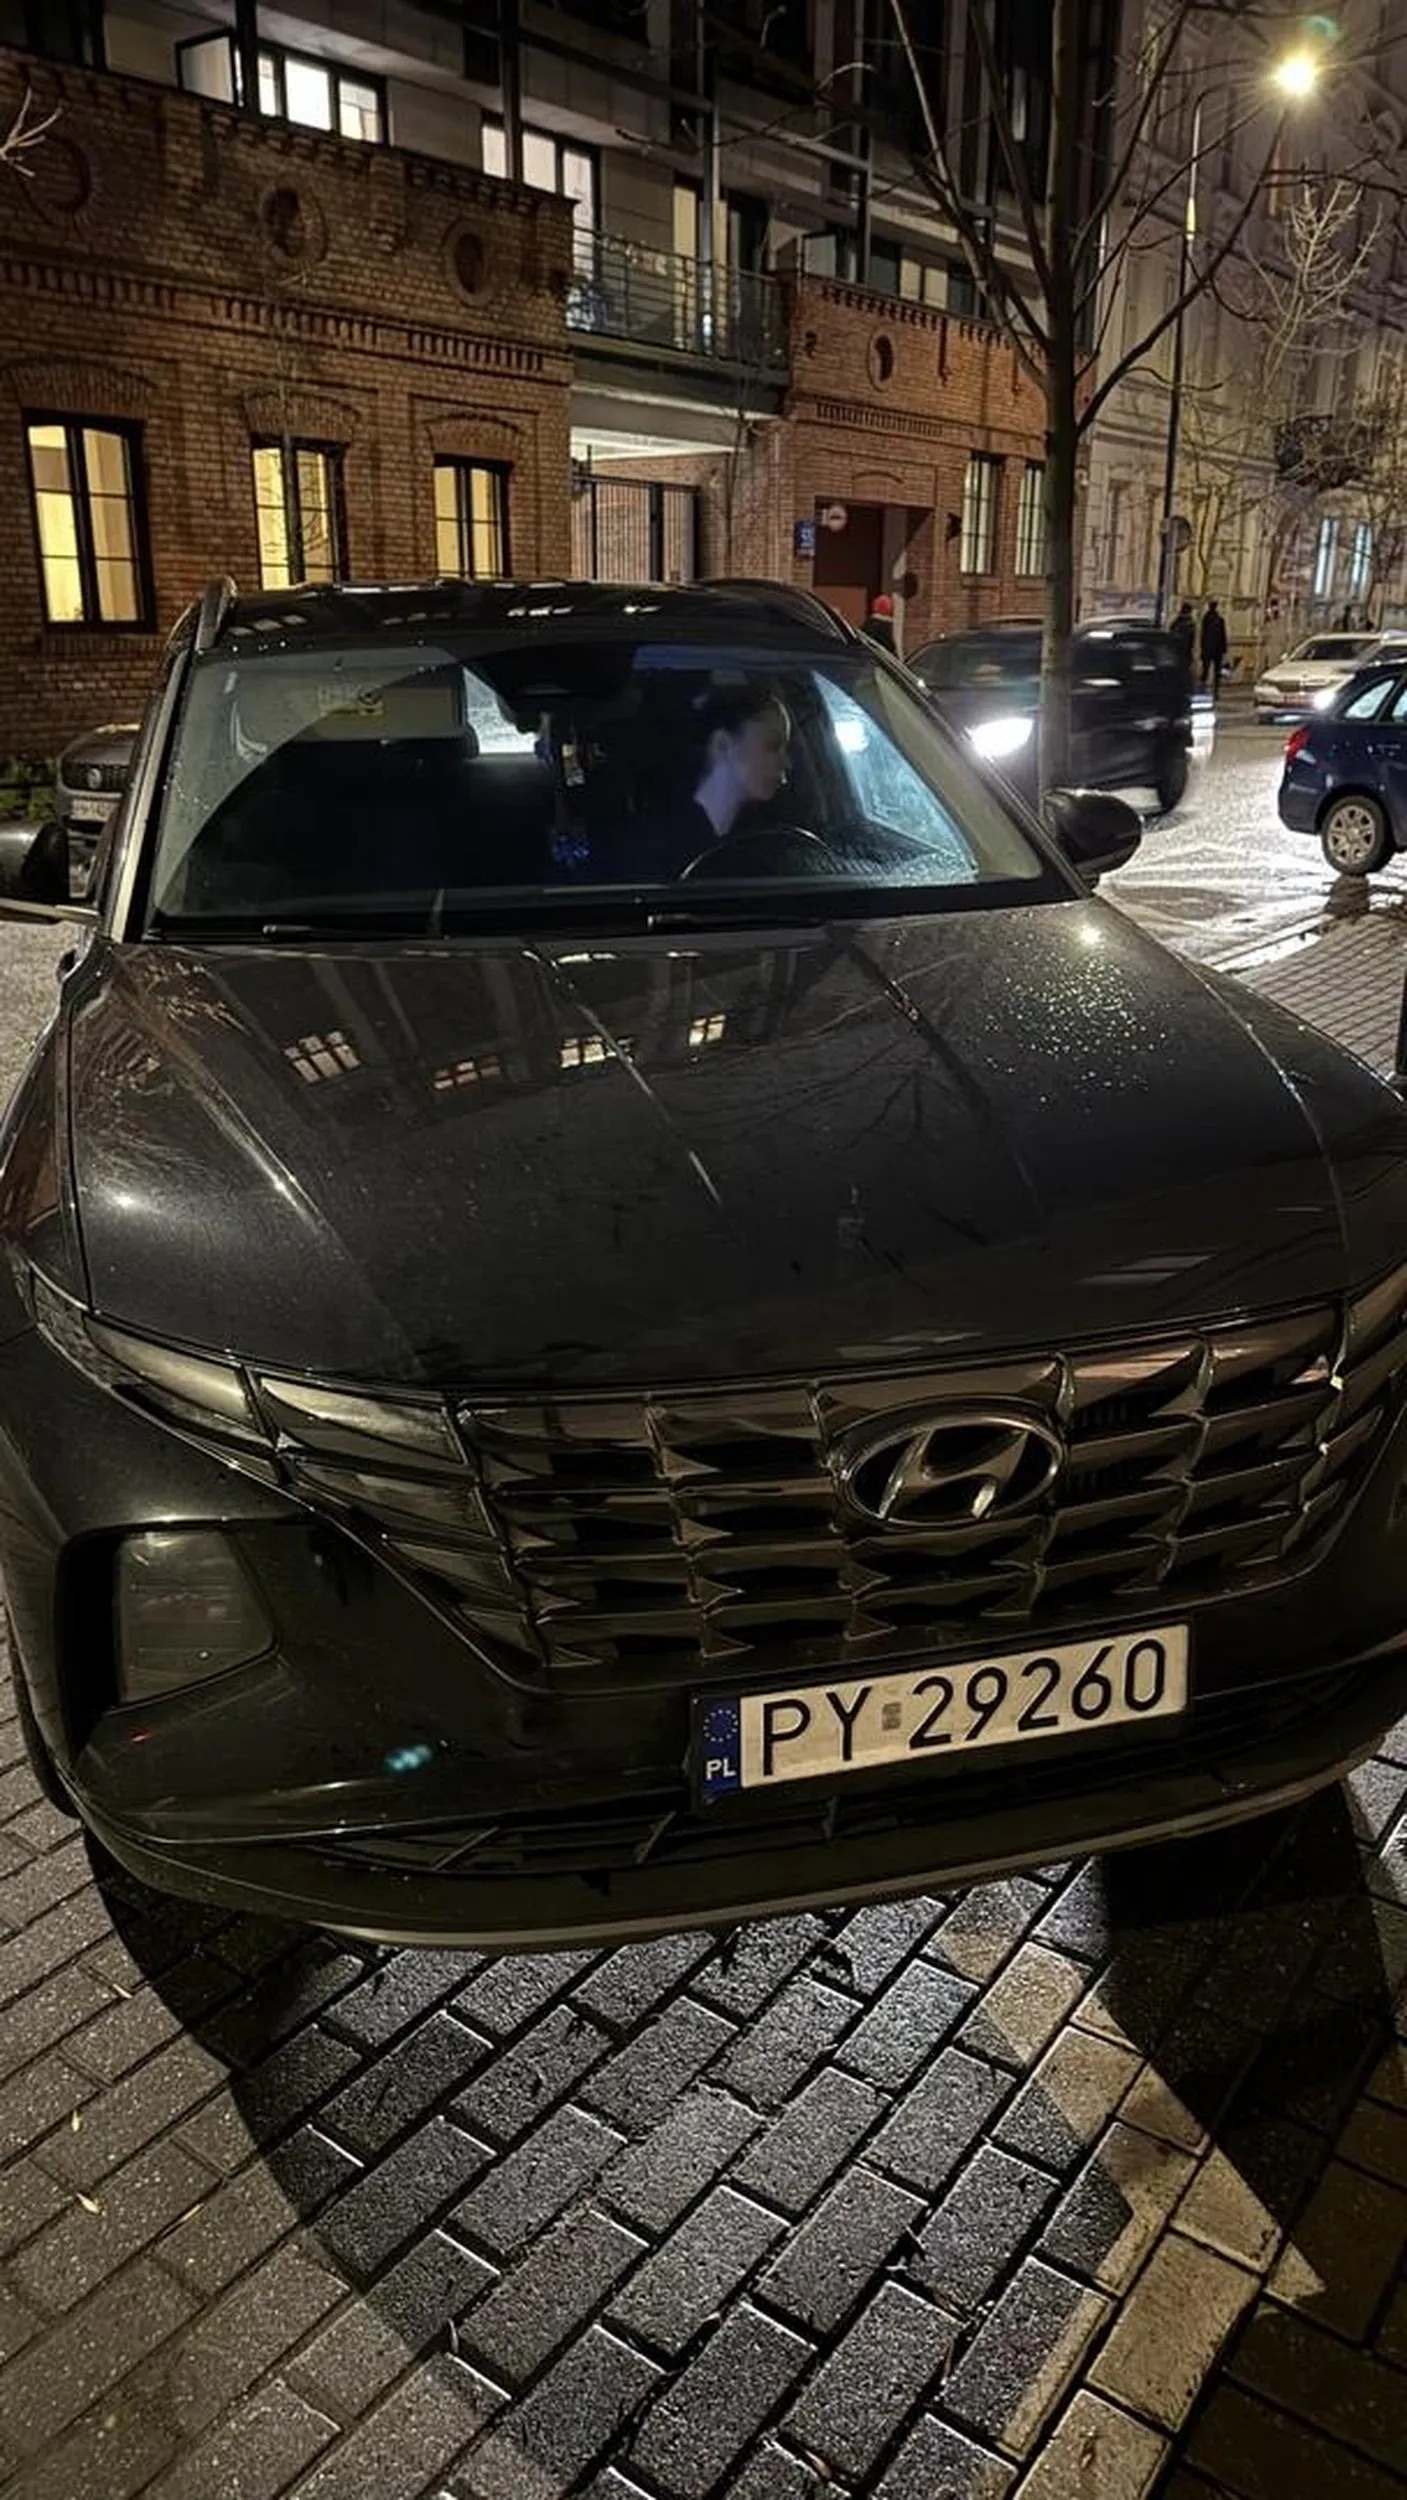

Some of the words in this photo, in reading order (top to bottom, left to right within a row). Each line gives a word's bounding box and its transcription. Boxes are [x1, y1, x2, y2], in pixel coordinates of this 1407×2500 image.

[763, 1686, 872, 1776] PY
[908, 1638, 1166, 1750] 29260
[706, 1757, 737, 1780] PL
